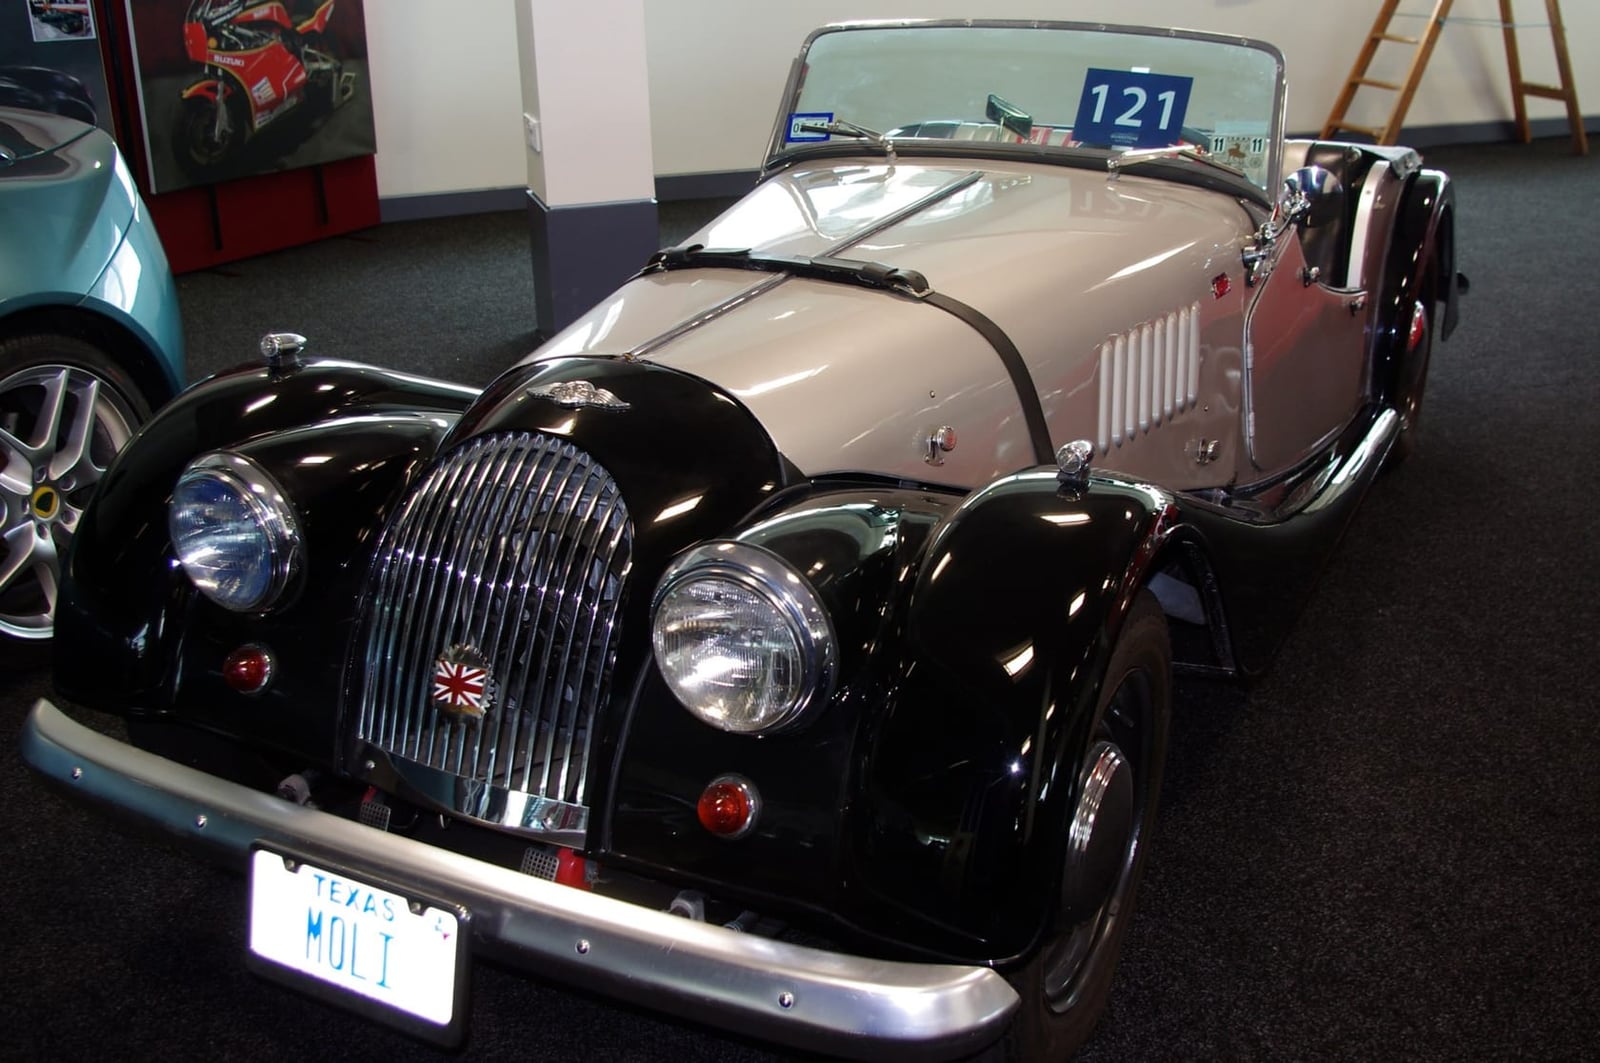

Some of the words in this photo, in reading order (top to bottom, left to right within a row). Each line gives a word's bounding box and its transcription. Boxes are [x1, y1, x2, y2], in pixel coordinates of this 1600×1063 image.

[1092, 84, 1176, 131] 121
[1213, 137, 1225, 151] 11
[1252, 138, 1263, 152] 11
[313, 874, 395, 922] TEXAS
[306, 907, 395, 989] MOLI
